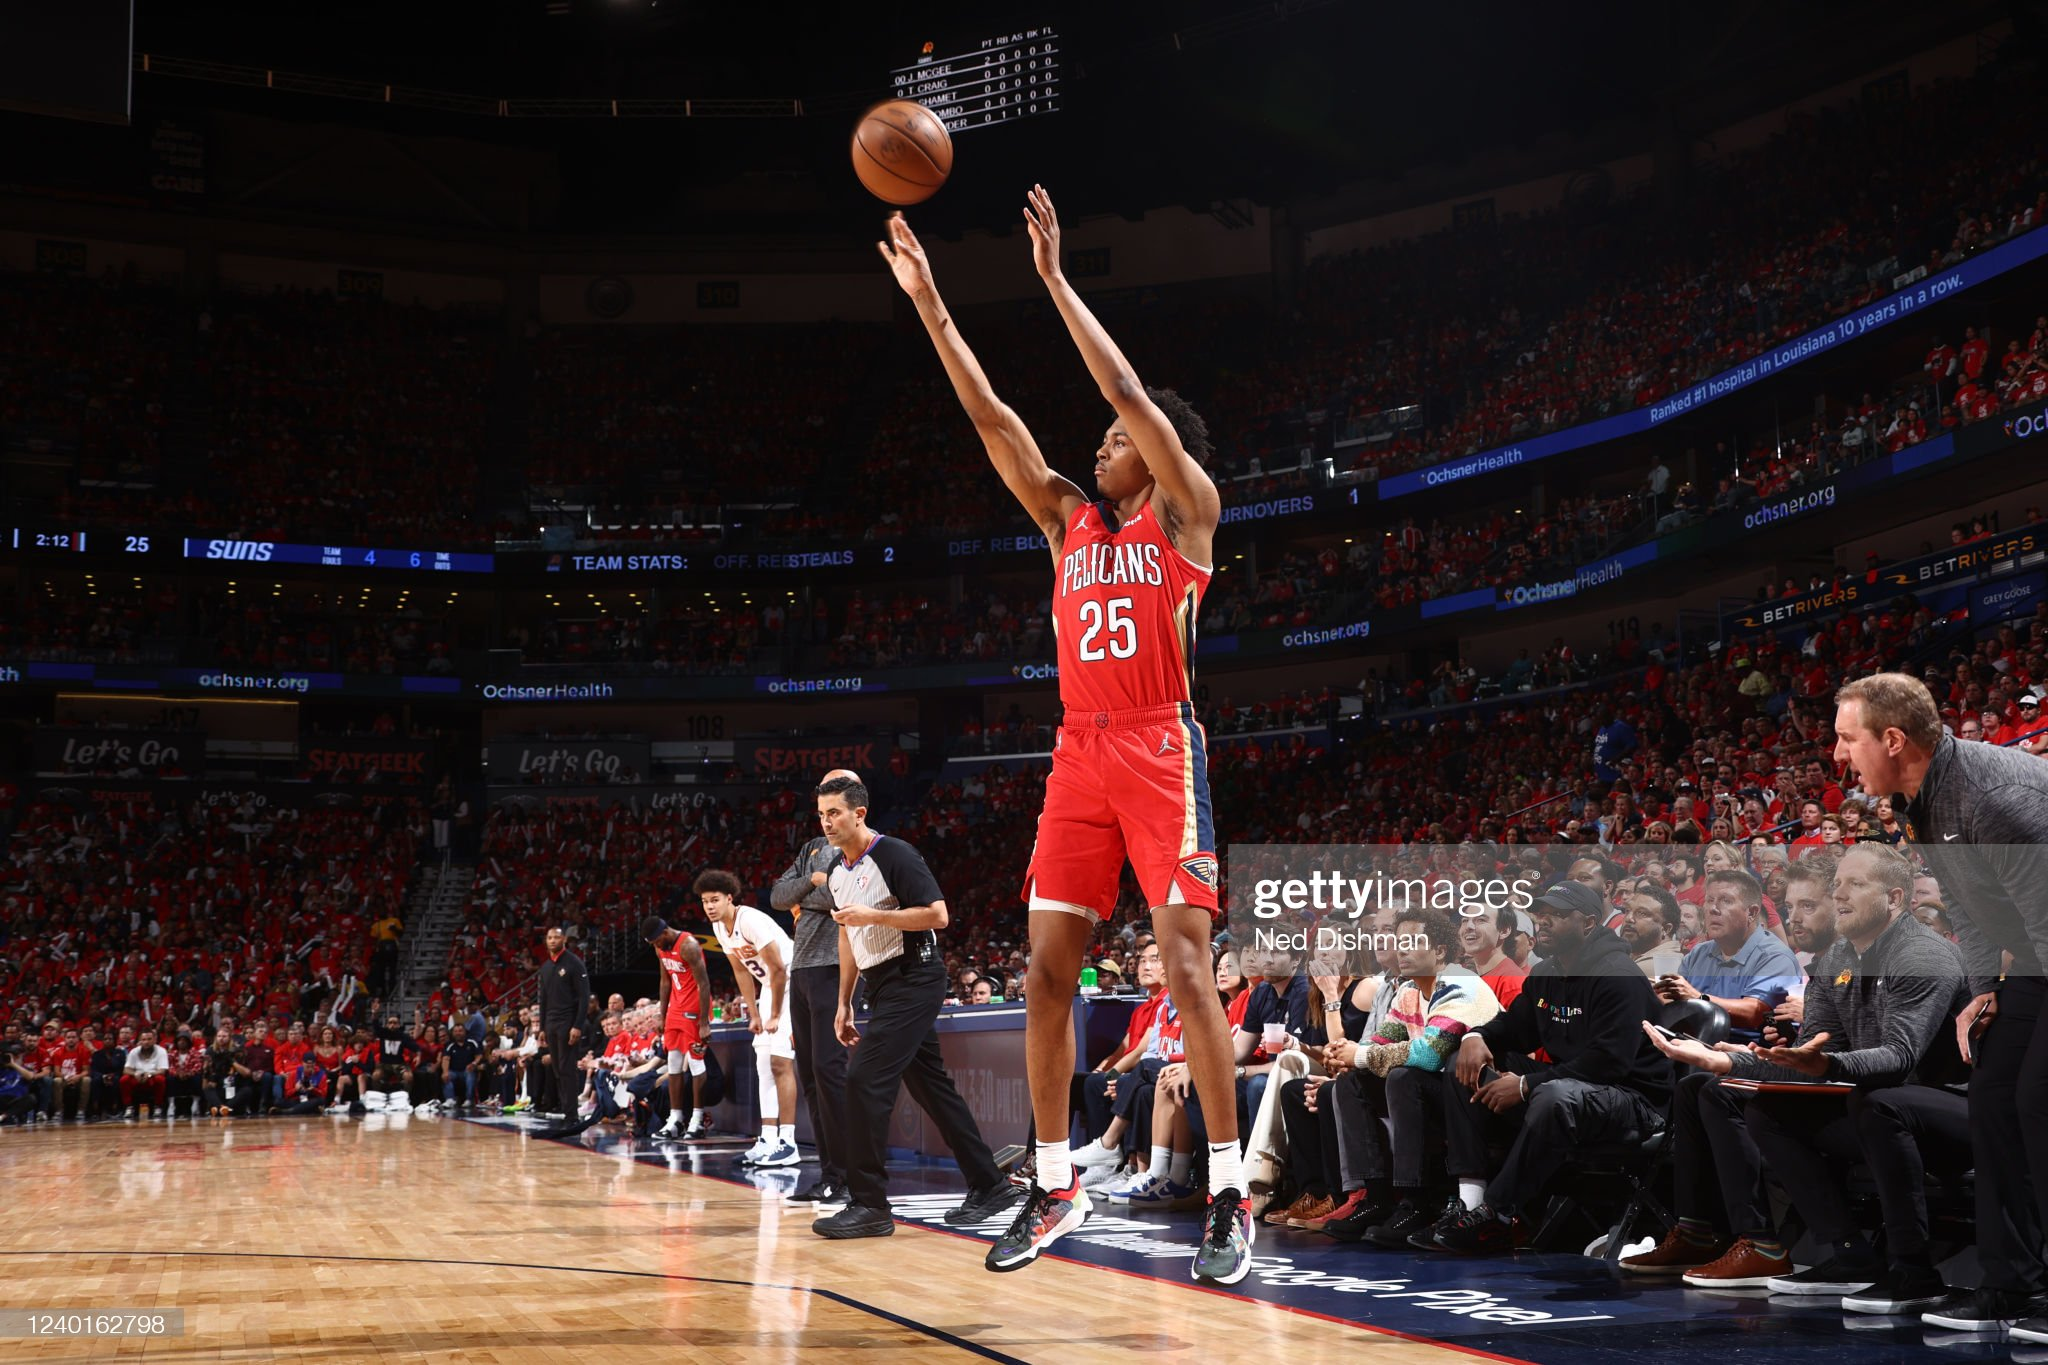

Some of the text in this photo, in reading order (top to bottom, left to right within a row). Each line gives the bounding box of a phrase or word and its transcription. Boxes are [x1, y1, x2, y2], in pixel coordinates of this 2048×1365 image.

[982, 26, 1052, 48] PT RB AS BK FL
[894, 76, 906, 85] 00
[917, 64, 951, 80] MCGEE
[984, 56, 991, 65] 2
[999, 53, 1006, 62] 0
[1014, 50, 1021, 59] 0
[1029, 47, 1036, 56] 0
[1045, 43, 1051, 52] 0
[897, 89, 903, 97] 0
[917, 79, 948, 93] CRAIG
[984, 70, 991, 79] 0
[999, 67, 1006, 76] 0
[1014, 63, 1021, 72] 0
[1030, 60, 1036, 69] 0
[1045, 57, 1051, 66] 0
[918, 72, 1052, 105] SHAMET 0 0 0 0 0
[936, 87, 1052, 119] OMBO 0 0 0 0 0
[985, 114, 991, 123] 0
[1002, 110, 1006, 119] 1
[1017, 108, 1021, 116] 1
[1030, 104, 1036, 113] 0
[1650, 396, 1691, 423] Ranked
[1694, 385, 1706, 402] #1
[1710, 362, 1757, 396] hospital
[1760, 358, 1771, 374] in
[1774, 331, 1836, 368] Louisiana
[1839, 320, 1854, 338] 10
[1858, 304, 1896, 334] years
[1900, 295, 1913, 313] in
[1917, 290, 1926, 303] a
[1930, 275, 1964, 298] row.
[1220, 488, 1358, 524] URNOVERS 1
[1744, 484, 1836, 528] ochsner.org
[35, 534, 70, 548] 2:12
[124, 536, 149, 552] 25
[324, 547, 341, 556] TEAM
[322, 556, 342, 566] FOULS
[364, 550, 376, 565] 4
[409, 553, 421, 567] 6
[434, 561, 451, 571] OUTS
[572, 556, 622, 571] TEAM
[628, 555, 688, 570] STATS:
[713, 554, 752, 568] OFF.
[884, 547, 894, 562] 2
[1062, 543, 1163, 598] PELICANS
[1763, 586, 1858, 624] BETRIVERS
[1983, 592, 2003, 605] GREY
[2004, 585, 2031, 599] GOOSE
[1078, 597, 1138, 662] 25
[1282, 620, 1370, 647] ochsner.org
[0, 666, 20, 682] th
[199, 674, 309, 692] ochsner.org
[1021, 664, 1059, 679] Ochs
[768, 676, 862, 694] ochsner.org
[687, 716, 724, 740] 108
[63, 738, 179, 765] Let's Go
[308, 748, 425, 774] SEATGEEK
[519, 750, 620, 775] Let's Go
[754, 742, 874, 774] SEATGEEK
[90, 789, 152, 802] SEATGEEK
[652, 792, 689, 808] Let's
[384, 1040, 401, 1055] W
